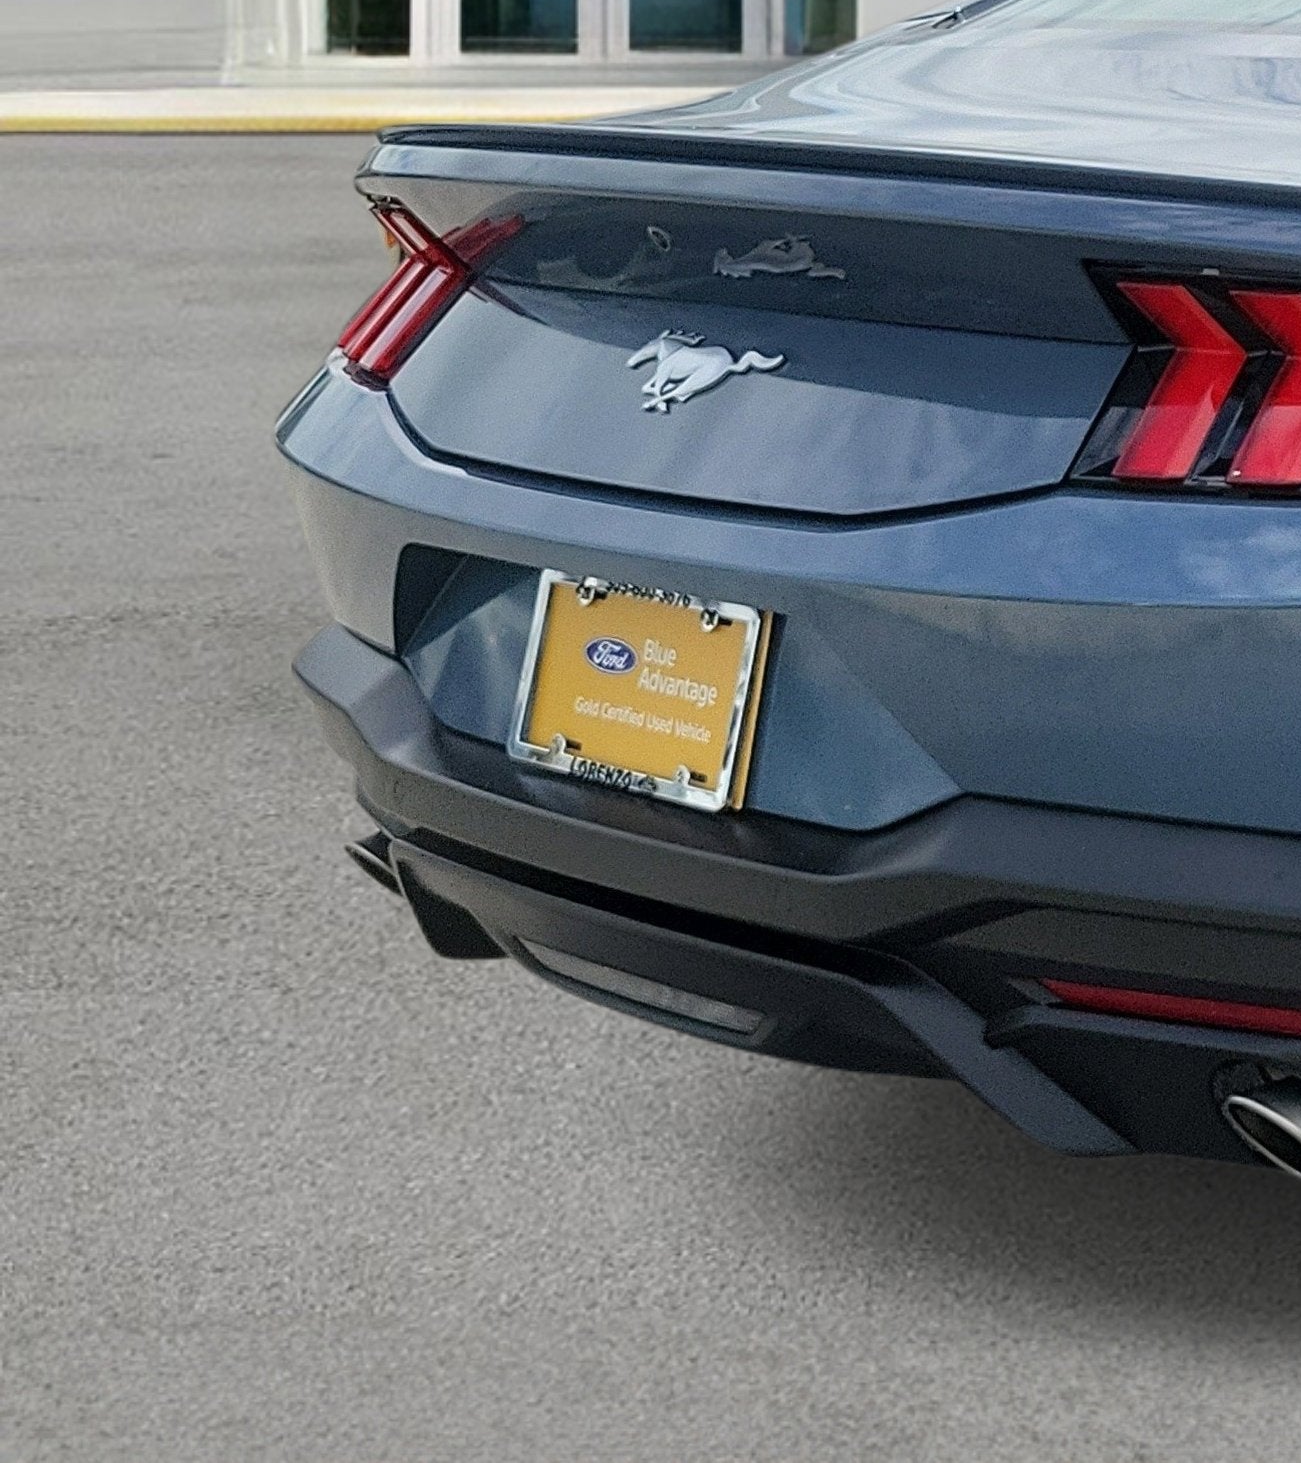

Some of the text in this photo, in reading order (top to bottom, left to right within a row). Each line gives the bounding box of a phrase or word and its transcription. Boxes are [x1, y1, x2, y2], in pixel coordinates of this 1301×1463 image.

[594, 640, 628, 670] Ford
[644, 639, 678, 668] Blue
[638, 668, 718, 707] Advantage
[575, 696, 712, 744] Gold Certified Used Vehicle
[570, 757, 631, 787] LORENZO
